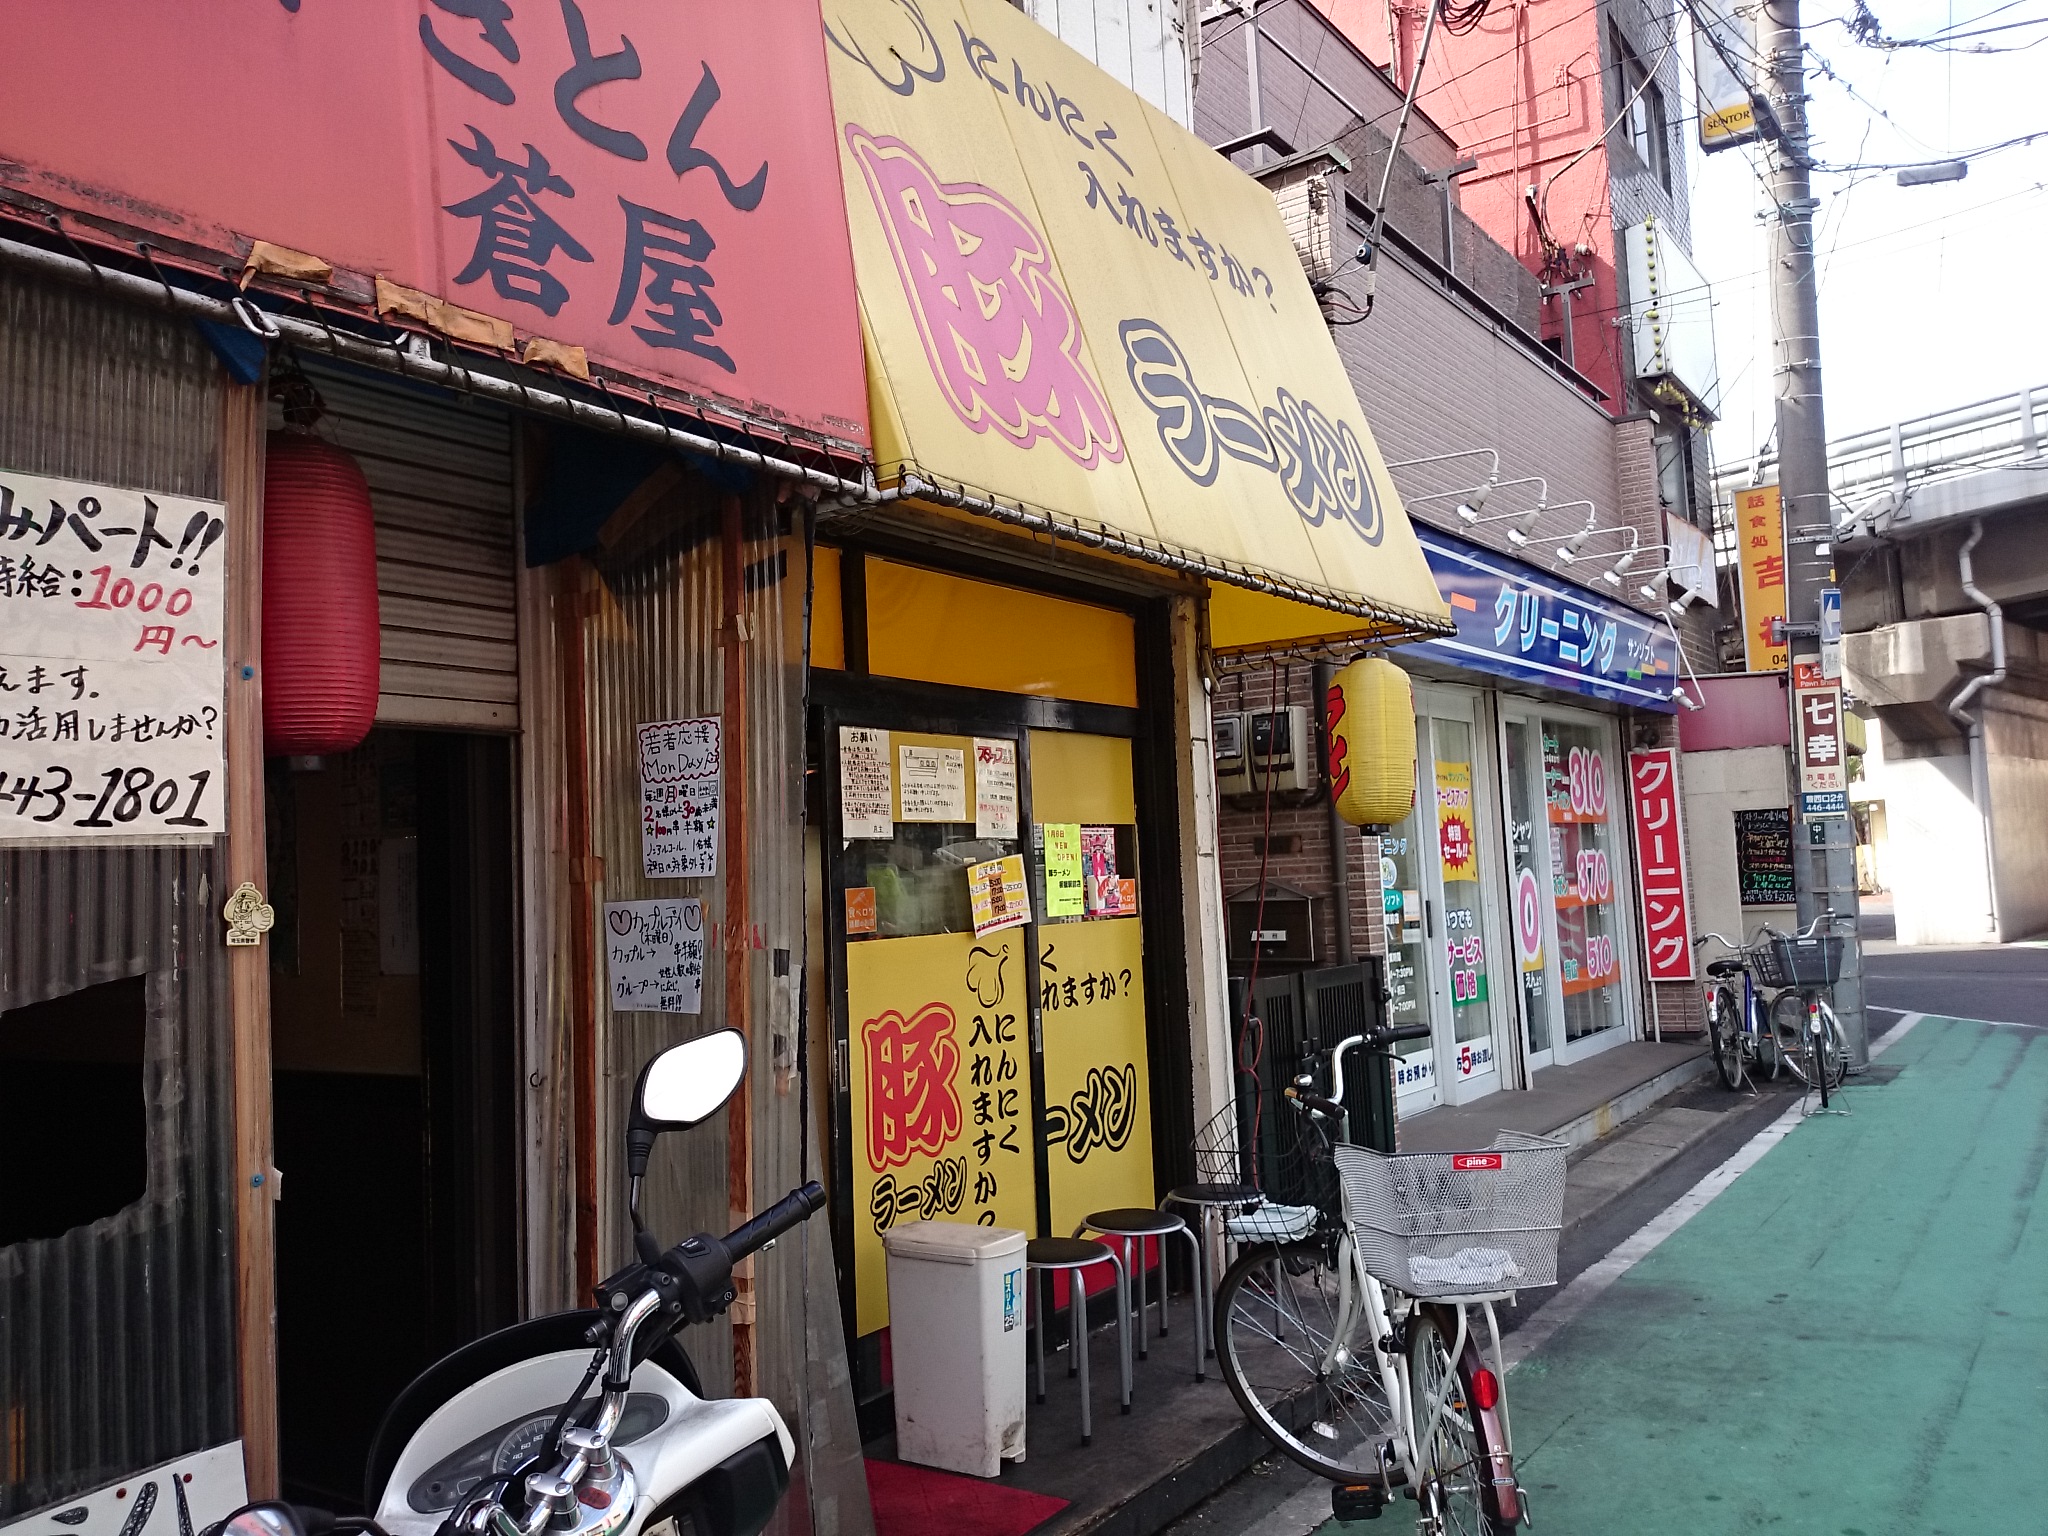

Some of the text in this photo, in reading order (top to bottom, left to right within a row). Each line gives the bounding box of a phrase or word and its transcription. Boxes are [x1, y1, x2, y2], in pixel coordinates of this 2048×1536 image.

[278, 0, 768, 212] きとん
[953, 18, 1134, 178] にんにく
[442, 123, 739, 375] 蒼屋
[1077, 159, 1279, 313] 入れますか?
[844, 122, 1126, 471] 豚
[1117, 317, 1385, 547] ラーメン
[1494, 582, 1618, 675] クリーニング
[1799, 666, 1822, 680] しち
[1800, 680, 1819, 688] Pawn
[645, 724, 711, 756] 若者応援
[850, 731, 879, 744] お願い
[1805, 697, 1837, 763] 七幸
[1568, 745, 1607, 816] 310
[1806, 802, 1845, 812] 446-4444
[1054, 841, 1068, 850] NEW
[1447, 824, 1462, 842] 特別
[1576, 847, 1609, 903] 370
[1636, 760, 1684, 970] クリーニング
[611, 944, 646, 964] カップル
[1040, 943, 1057, 973] く
[1586, 933, 1613, 980] 510
[1041, 968, 1132, 1012] れますか?
[1454, 968, 1478, 1002] 価格
[861, 1001, 964, 1174] 豚
[994, 1013, 1021, 1155] にんにく
[1466, 1156, 1488, 1168] pine
[870, 1155, 968, 1237] ラーメン
